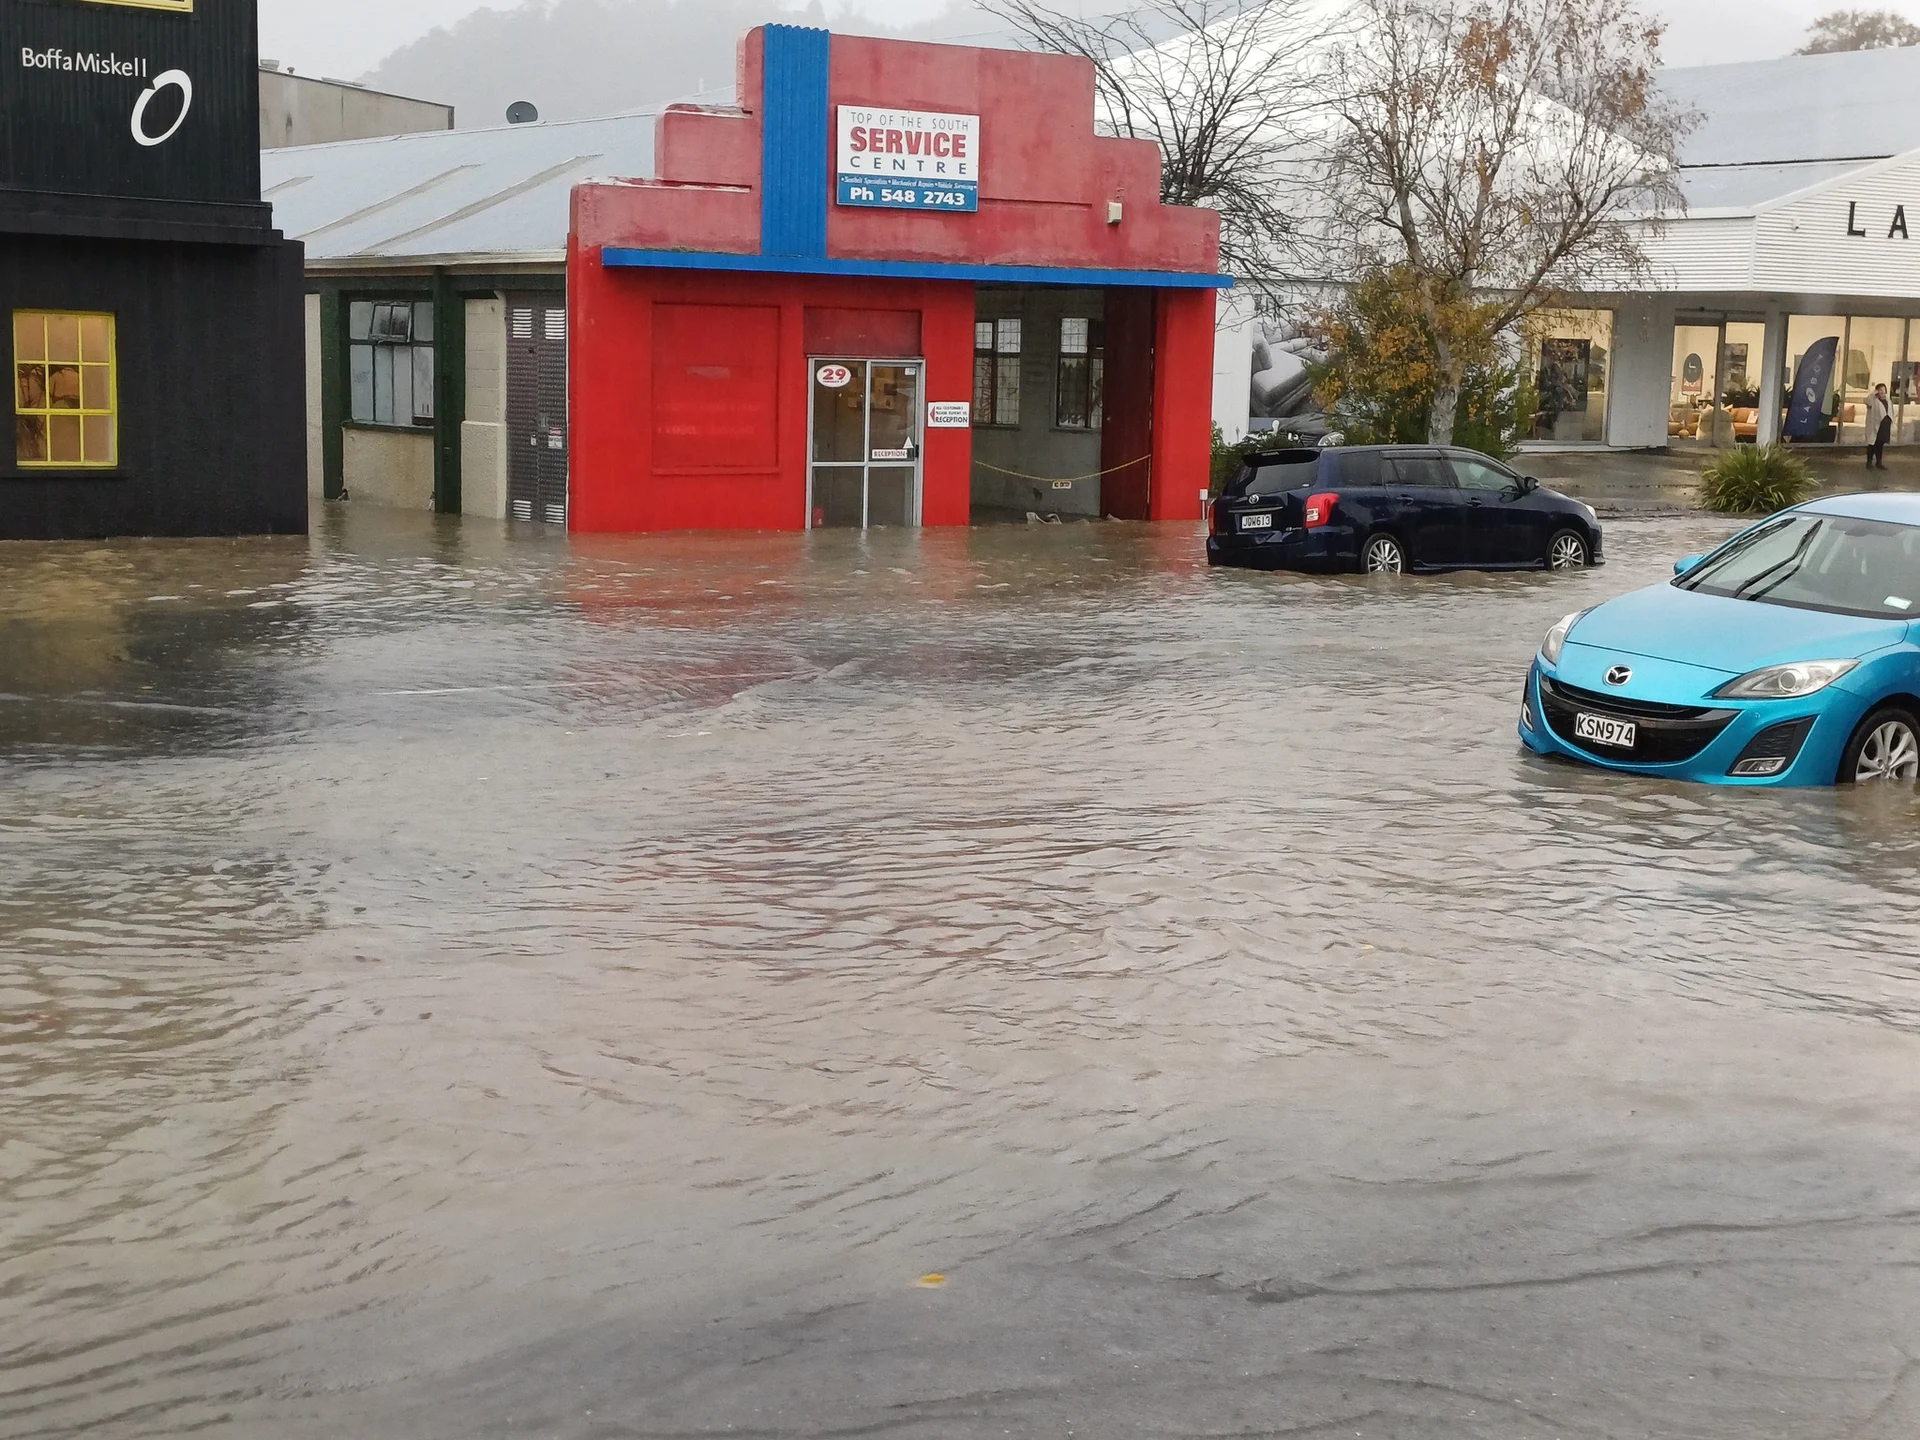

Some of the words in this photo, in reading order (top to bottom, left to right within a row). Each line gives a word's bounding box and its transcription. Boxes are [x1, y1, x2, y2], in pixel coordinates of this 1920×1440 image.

[880, 114, 894, 126] OF
[901, 116, 922, 129] THE
[850, 126, 966, 158] SERVICE
[850, 156, 967, 175] CENTRE
[850, 187, 874, 200] Ph
[881, 188, 915, 203] 548
[923, 191, 965, 206] 2743
[822, 368, 847, 380] 29
[1577, 716, 1633, 744] KSN974
